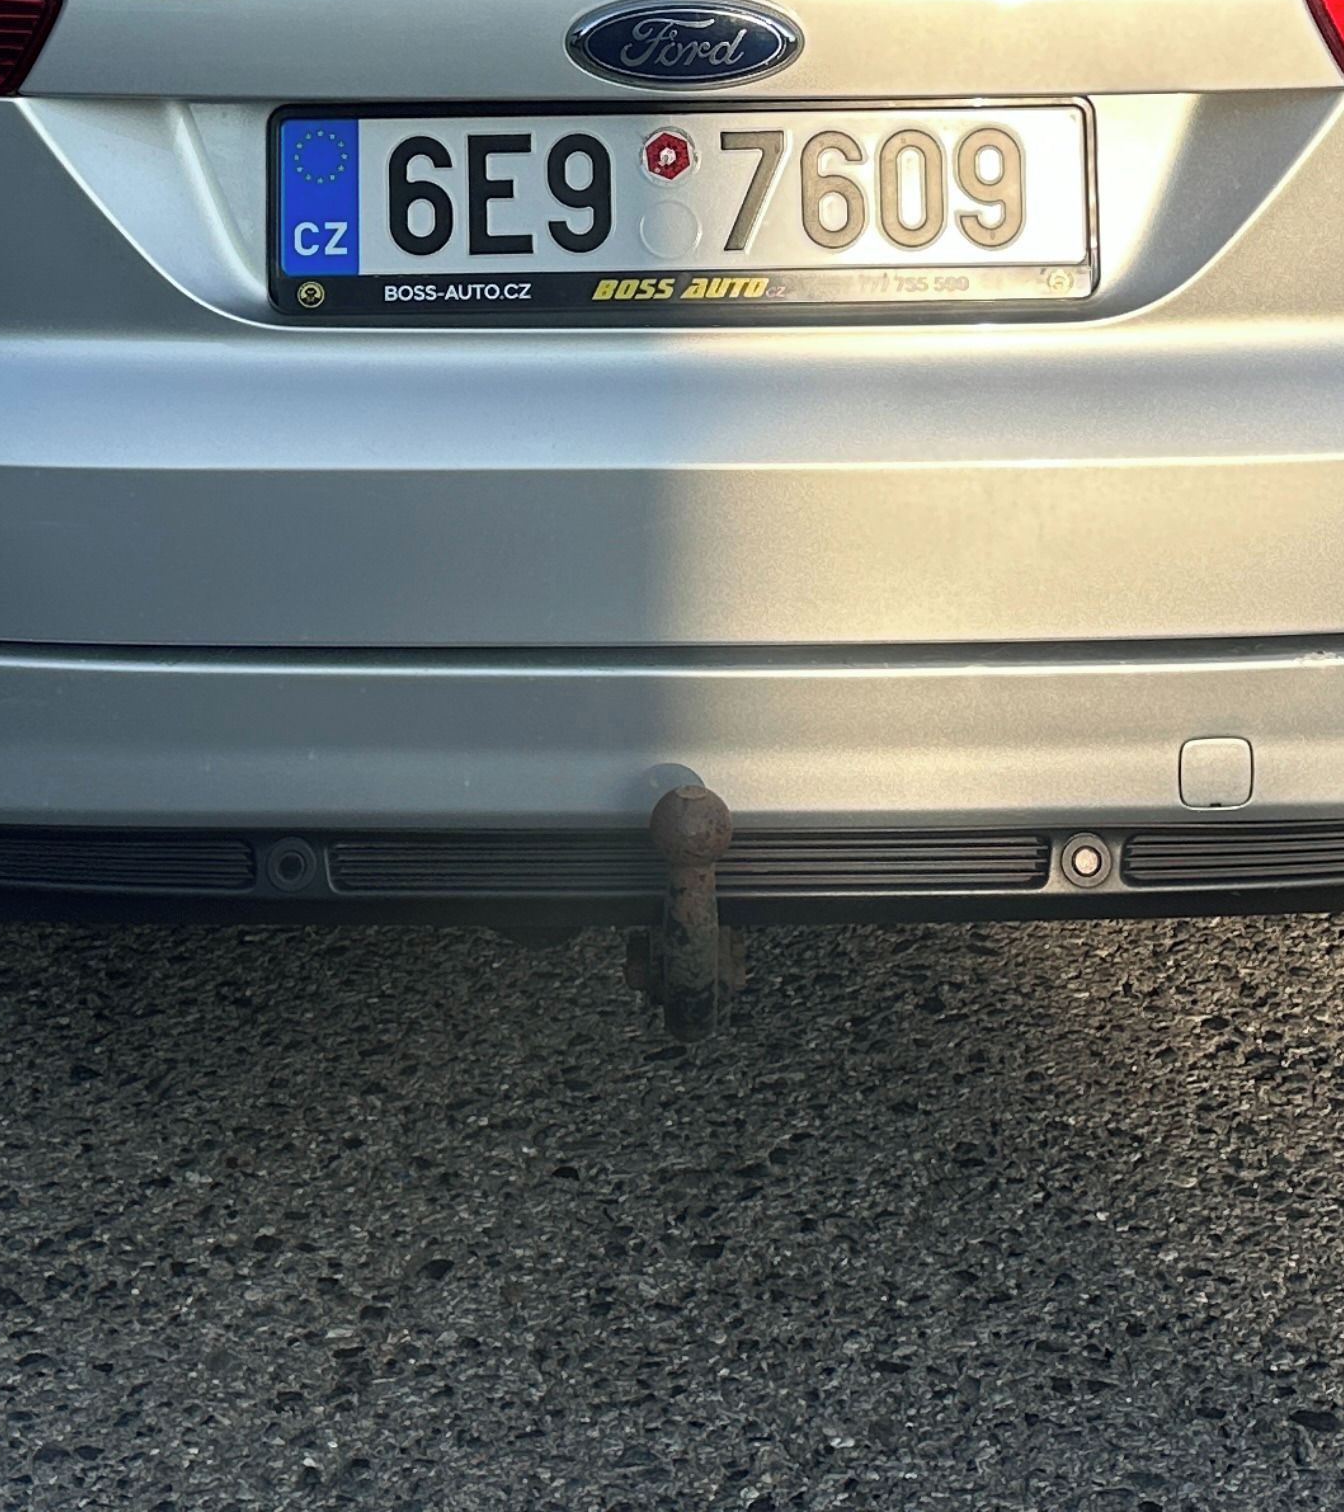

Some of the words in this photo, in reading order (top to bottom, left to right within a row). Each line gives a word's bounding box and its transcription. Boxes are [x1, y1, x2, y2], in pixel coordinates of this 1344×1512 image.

[620, 18, 745, 67] Ford
[388, 133, 613, 256] 6E9
[720, 126, 1024, 252] 7609
[294, 221, 348, 256] CZ
[383, 283, 532, 302] BOSS-AUTO.CZ
[591, 278, 676, 301] BOSS
